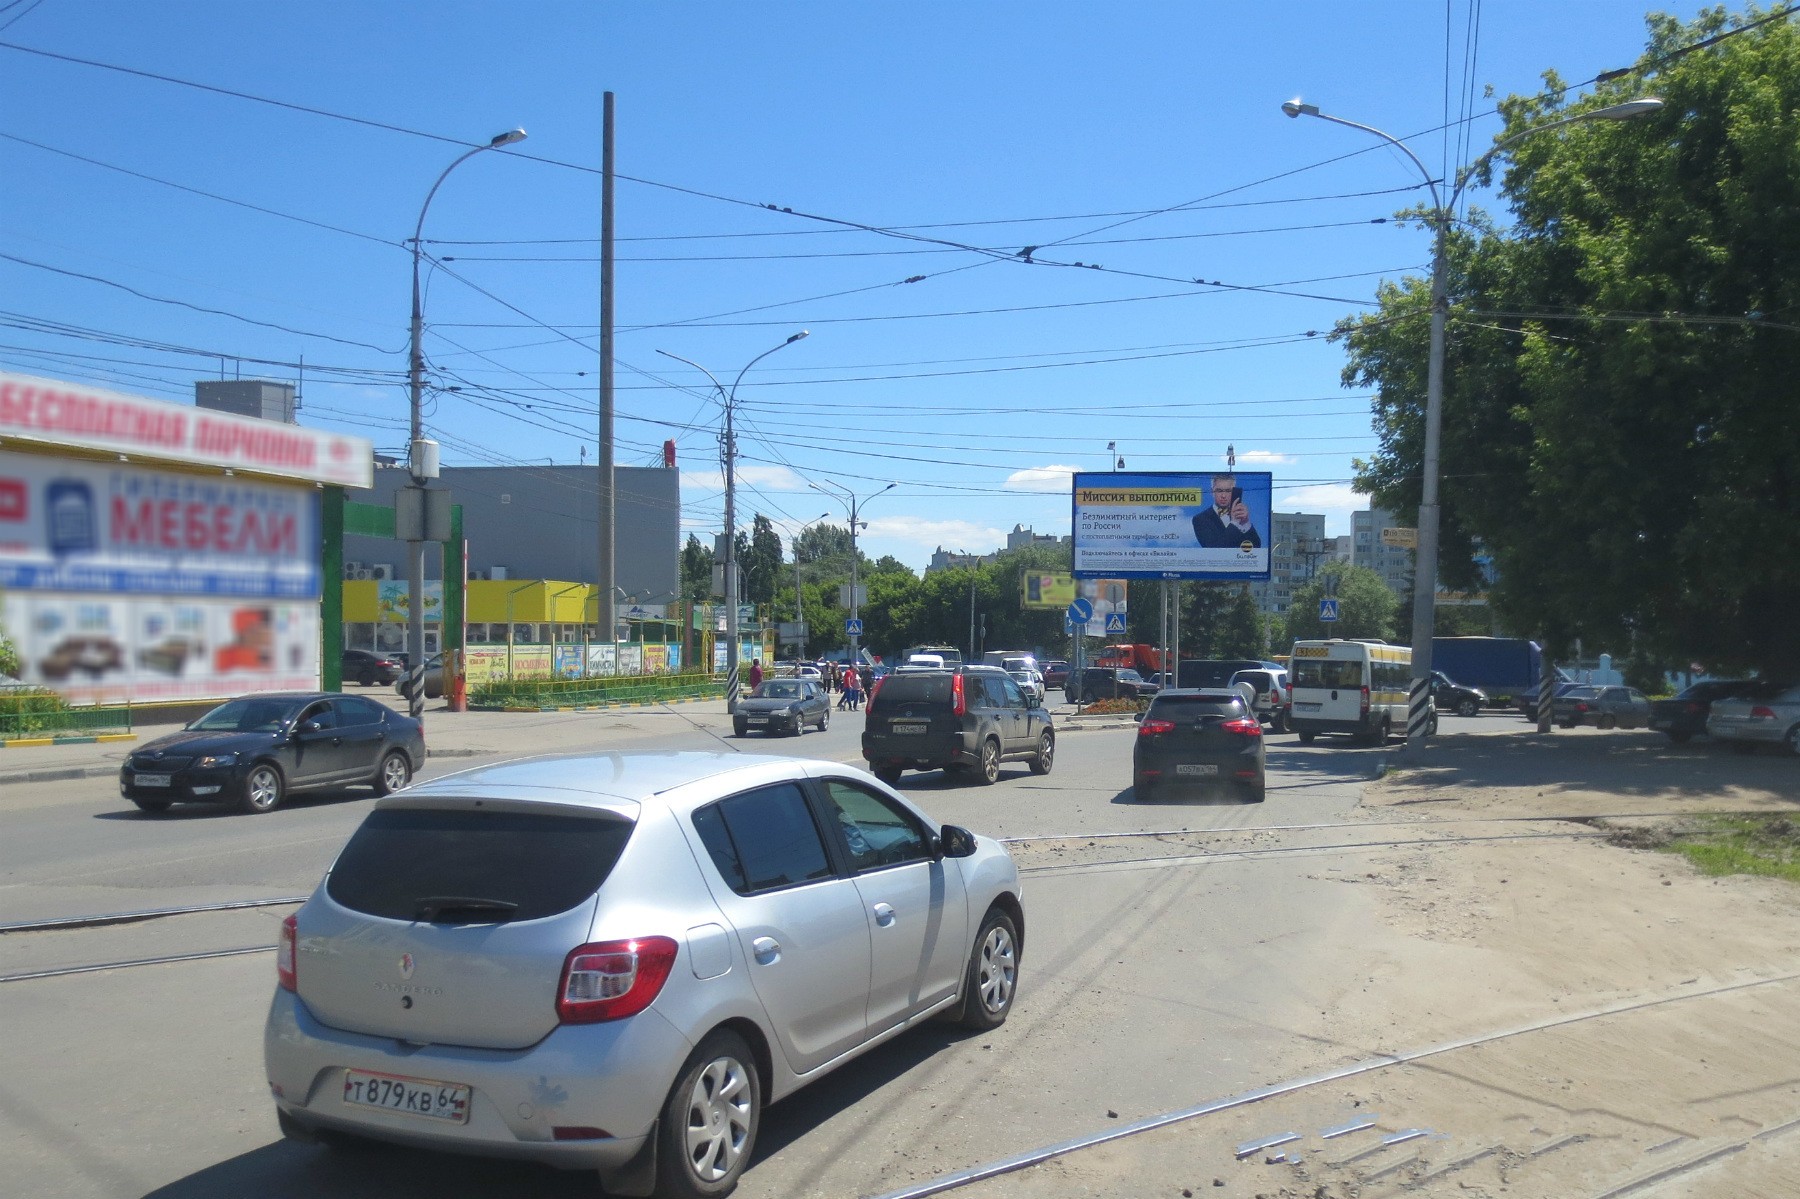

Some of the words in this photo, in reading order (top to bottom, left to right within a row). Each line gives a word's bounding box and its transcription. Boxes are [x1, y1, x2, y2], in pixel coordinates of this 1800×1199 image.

[1082, 490, 1125, 502] Миссия
[1128, 492, 1197, 502] выполнима
[1082, 512, 1137, 521] Безлимитный
[1139, 514, 1177, 522] интернет
[110, 494, 297, 556] МЕБЕЛИ
[1093, 521, 1121, 530] России
